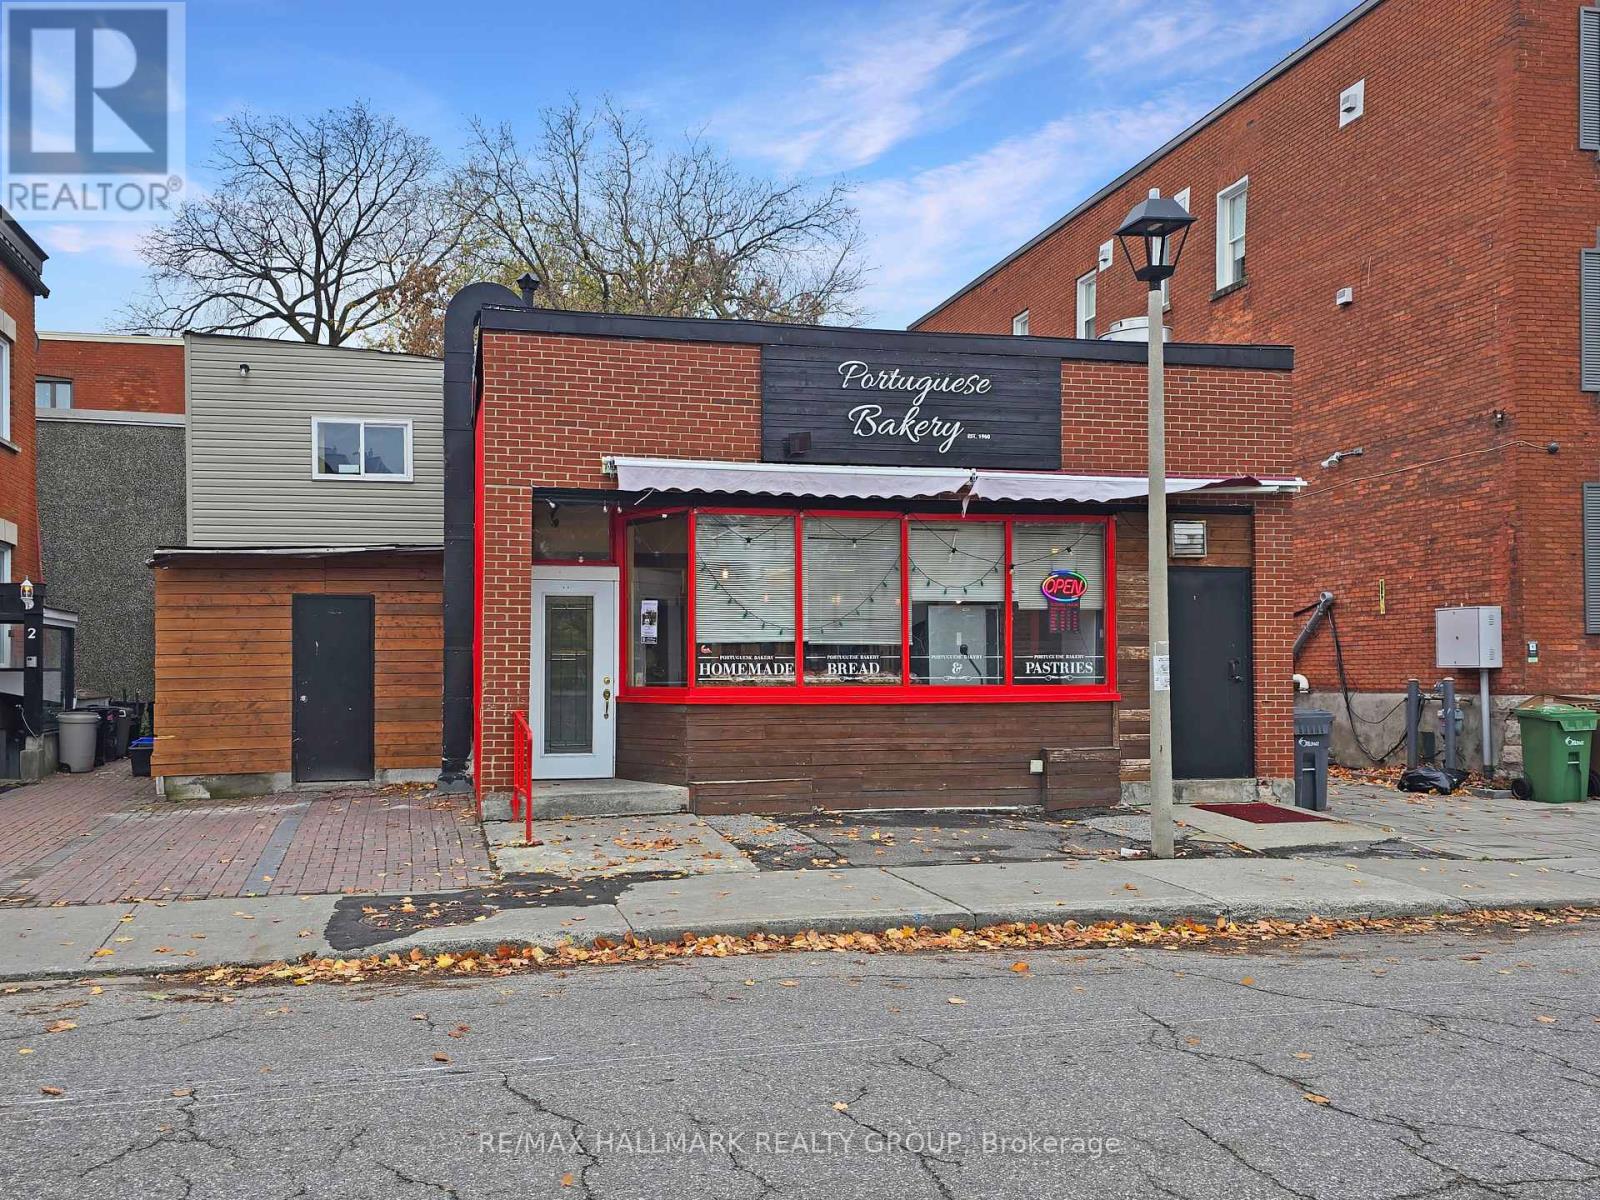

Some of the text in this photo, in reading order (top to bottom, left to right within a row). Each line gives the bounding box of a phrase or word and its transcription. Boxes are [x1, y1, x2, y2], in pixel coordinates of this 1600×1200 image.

[838, 360, 992, 406] Portuguese
[848, 404, 964, 454] Bakery
[1045, 578, 1083, 595] OPEN
[27, 627, 37, 639] 2
[699, 662, 795, 676] HOMEMADE
[827, 662, 880, 675] BREAD
[951, 661, 963, 674] &
[1025, 661, 1093, 674] PASTRIES
